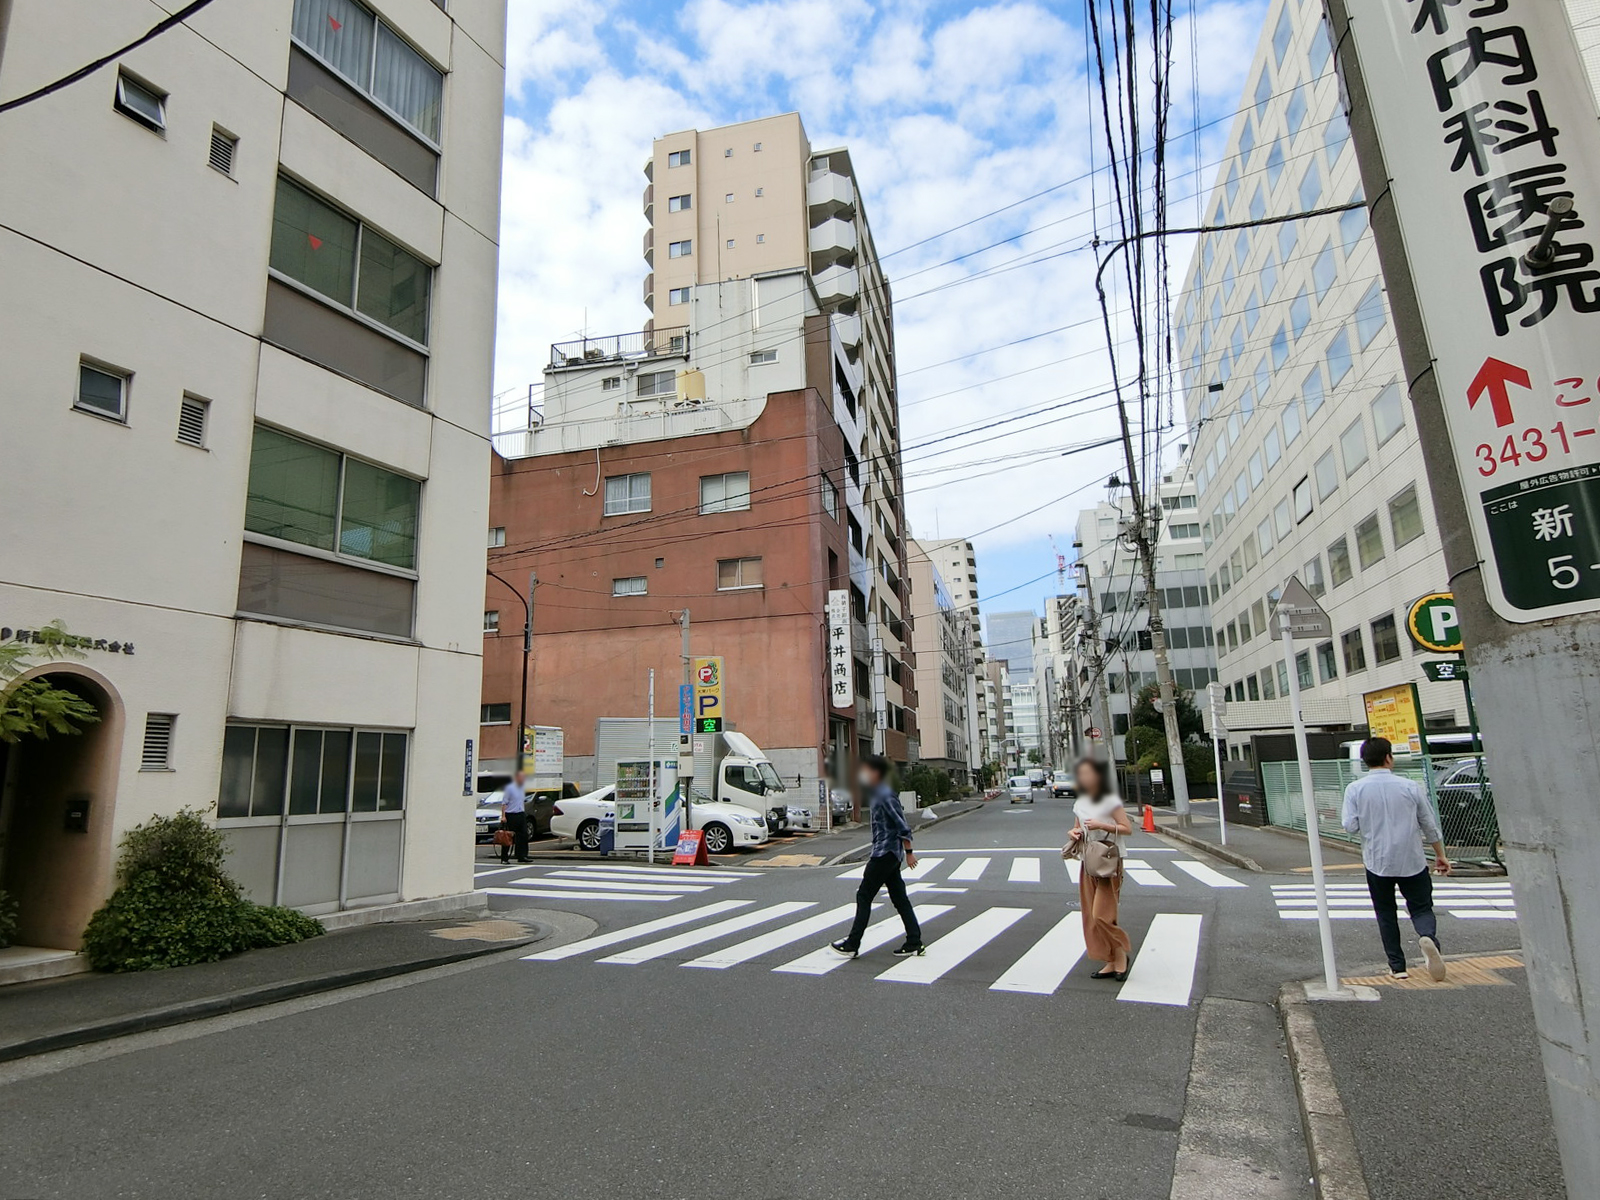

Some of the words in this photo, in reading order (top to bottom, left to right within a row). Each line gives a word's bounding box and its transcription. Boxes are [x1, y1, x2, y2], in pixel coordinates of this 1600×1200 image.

[1553, 374, 1600, 407] こ
[1519, 467, 1590, 490] 屋外広告物許可
[1490, 500, 1519, 515] ここは
[1531, 504, 1573, 542] 新
[1428, 605, 1459, 642] P
[831, 627, 848, 695] 平井商店
[1435, 662, 1456, 679] 空
[699, 668, 712, 680] P
[699, 695, 719, 716] P
[703, 718, 716, 732] 空
